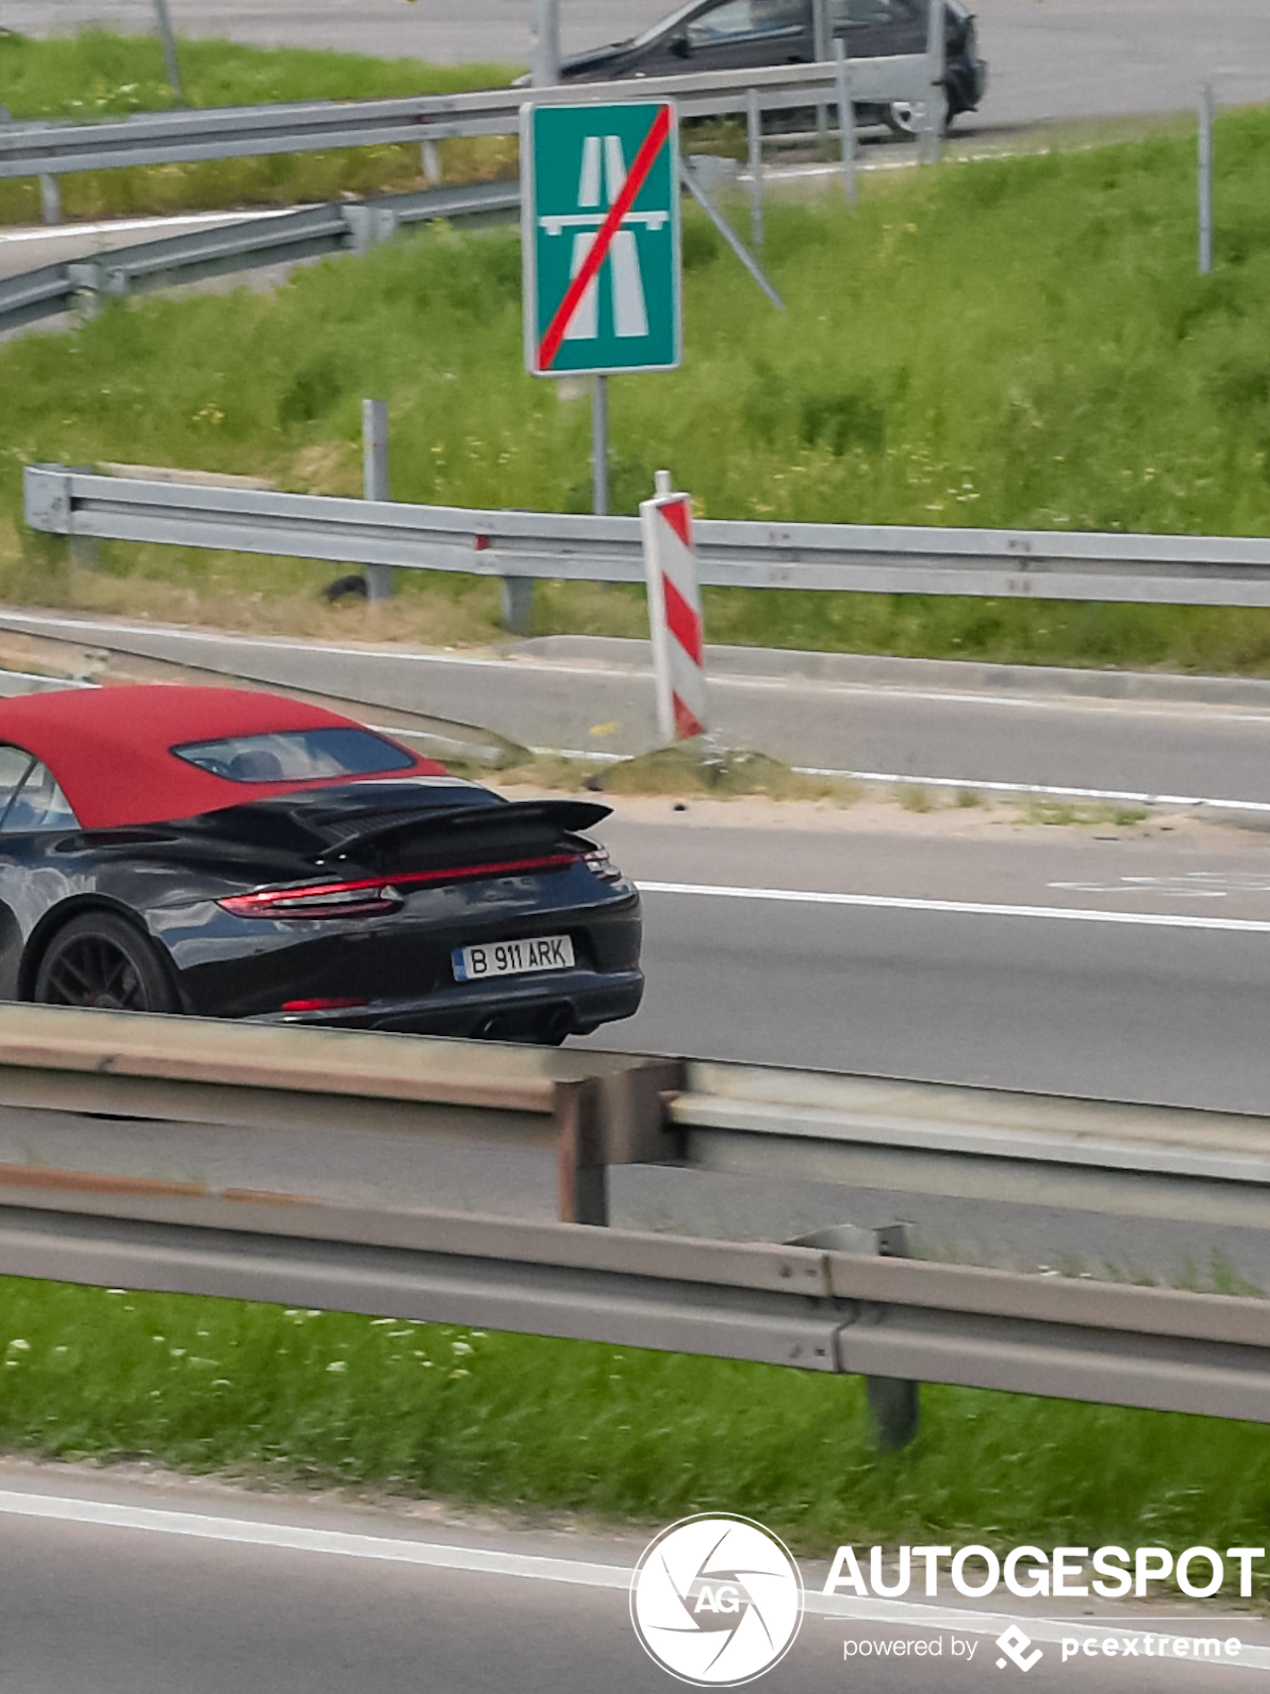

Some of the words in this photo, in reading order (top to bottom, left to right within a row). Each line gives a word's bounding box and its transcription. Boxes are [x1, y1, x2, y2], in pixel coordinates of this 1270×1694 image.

[470, 949, 487, 974] B
[495, 945, 523, 971] 911
[529, 939, 566, 967] ARK
